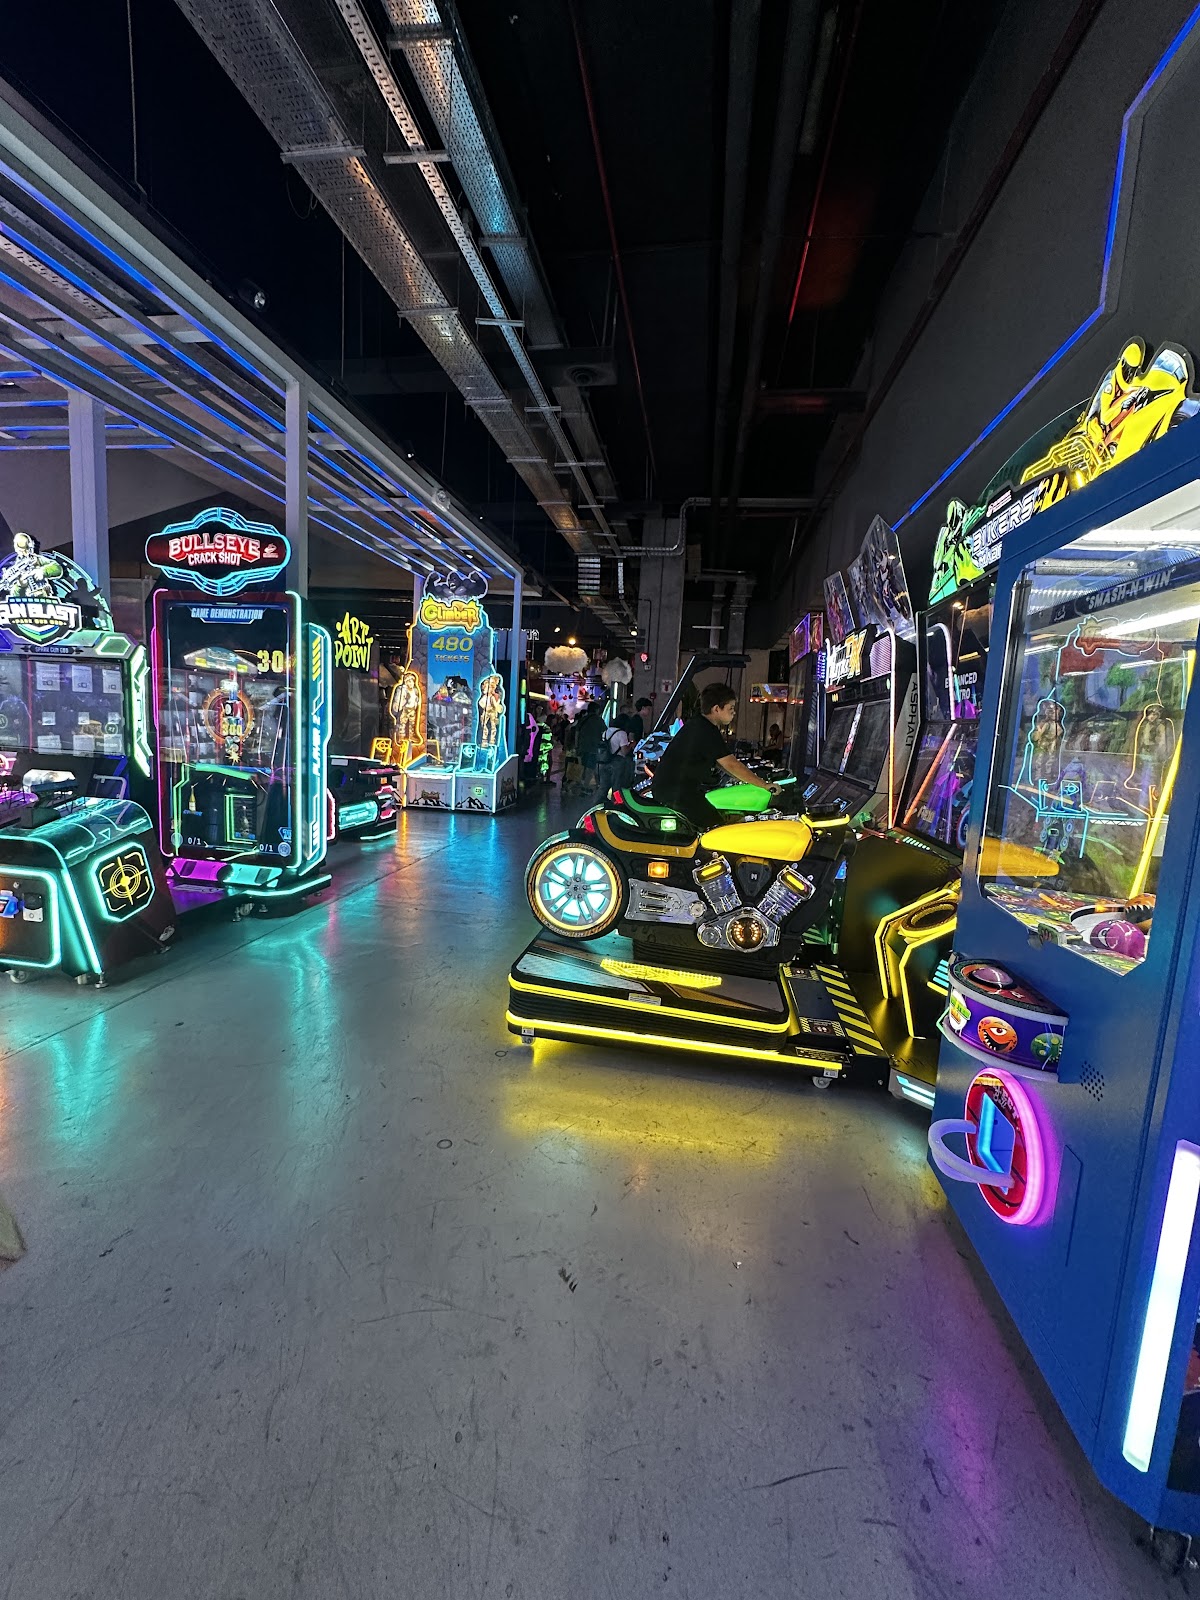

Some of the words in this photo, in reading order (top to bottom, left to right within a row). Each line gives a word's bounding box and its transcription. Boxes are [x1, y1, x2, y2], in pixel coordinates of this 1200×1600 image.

[972, 487, 1039, 551] BIKERS
[168, 533, 260, 559] BULLSEYE
[188, 552, 217, 566] CRACK
[218, 552, 241, 566] SHOT
[28, 603, 77, 628] BLAST
[191, 608, 209, 618] GAME
[210, 608, 264, 619] DEMONSTRATION
[336, 612, 369, 644] ART
[334, 637, 373, 671] POINT
[432, 637, 473, 651] 480
[435, 654, 470, 663] TICKETS
[905, 682, 918, 750] ASPHALT
[188, 837, 201, 845] 0/1
[259, 844, 274, 852] 0/1
